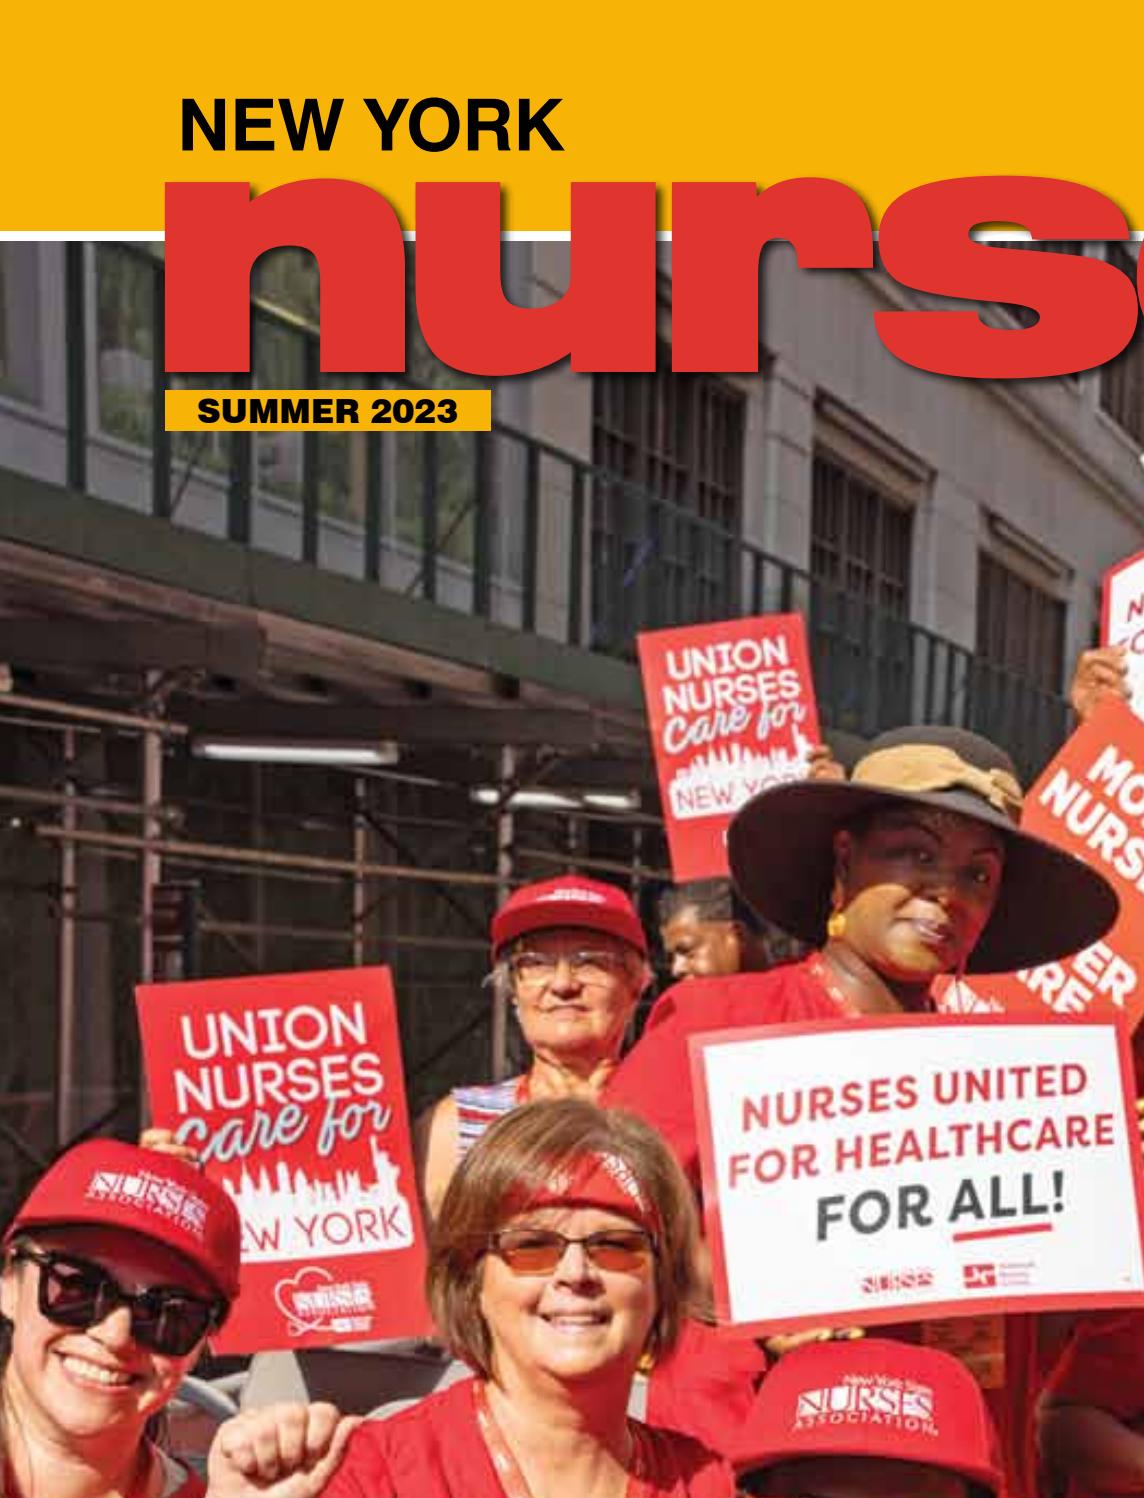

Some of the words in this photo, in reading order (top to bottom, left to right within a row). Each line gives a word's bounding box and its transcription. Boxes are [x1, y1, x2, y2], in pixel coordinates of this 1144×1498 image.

[665, 635, 789, 681] UNION
[662, 669, 801, 715] NURSES
[663, 703, 750, 755] Care
[756, 700, 807, 741] for
[676, 781, 733, 813] NEW
[180, 1002, 368, 1061] UNION
[173, 1052, 385, 1115] NURSES
[742, 1075, 919, 1133] NURSES
[933, 1062, 1089, 1106] UNITED
[176, 1097, 310, 1163] Care
[317, 1095, 391, 1157] for
[727, 1143, 820, 1190] FOR
[835, 1112, 1116, 1174] HEALTHCARE
[294, 1203, 406, 1248] YORK
[816, 1183, 932, 1242] FOR
[948, 1169, 1066, 1224] ALL!
[796, 1385, 934, 1420] NURSES
